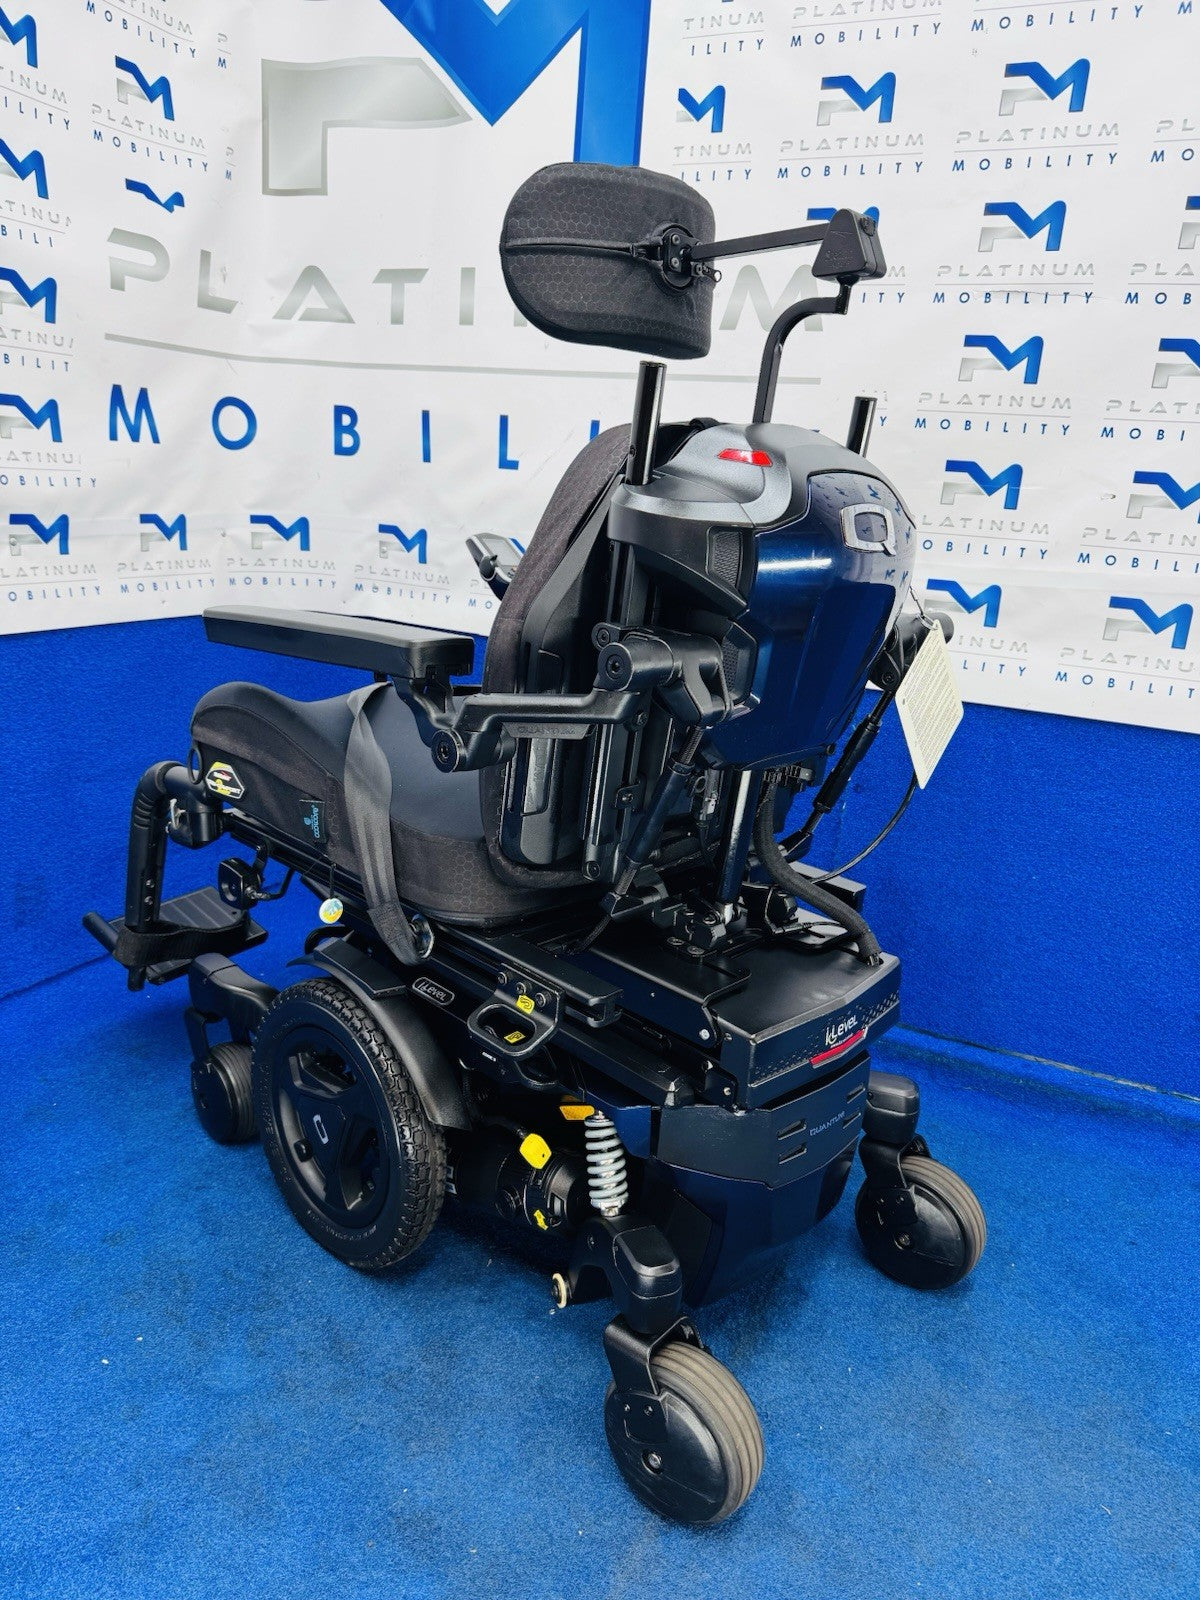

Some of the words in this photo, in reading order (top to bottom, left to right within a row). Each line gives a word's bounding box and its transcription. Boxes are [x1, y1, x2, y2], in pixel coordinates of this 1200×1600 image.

[971, 4, 1144, 32] MOBILITY
[85, 0, 196, 58] MOBILITY
[790, 23, 941, 48] MOBILITY
[91, 103, 205, 149] PLATINUM
[956, 122, 1119, 145] PLATINUM
[93, 129, 208, 172] MOBILITY
[780, 133, 924, 153] PLATINUM
[777, 161, 923, 179] MOBILITY
[952, 152, 1118, 173] MOBILITY
[937, 262, 1095, 277] PLATINUM
[933, 291, 1093, 304] MOBILITY
[918, 392, 1072, 411] PLATINUM
[915, 417, 1071, 437] MOBILITY
[117, 558, 212, 572] PLATINUM
[227, 557, 336, 570] PLATINUM
[229, 576, 336, 589] MOBILITY
[354, 564, 450, 585] PLATINUM
[120, 578, 216, 594] MOBILITY
[354, 583, 451, 604] MOBILITY
